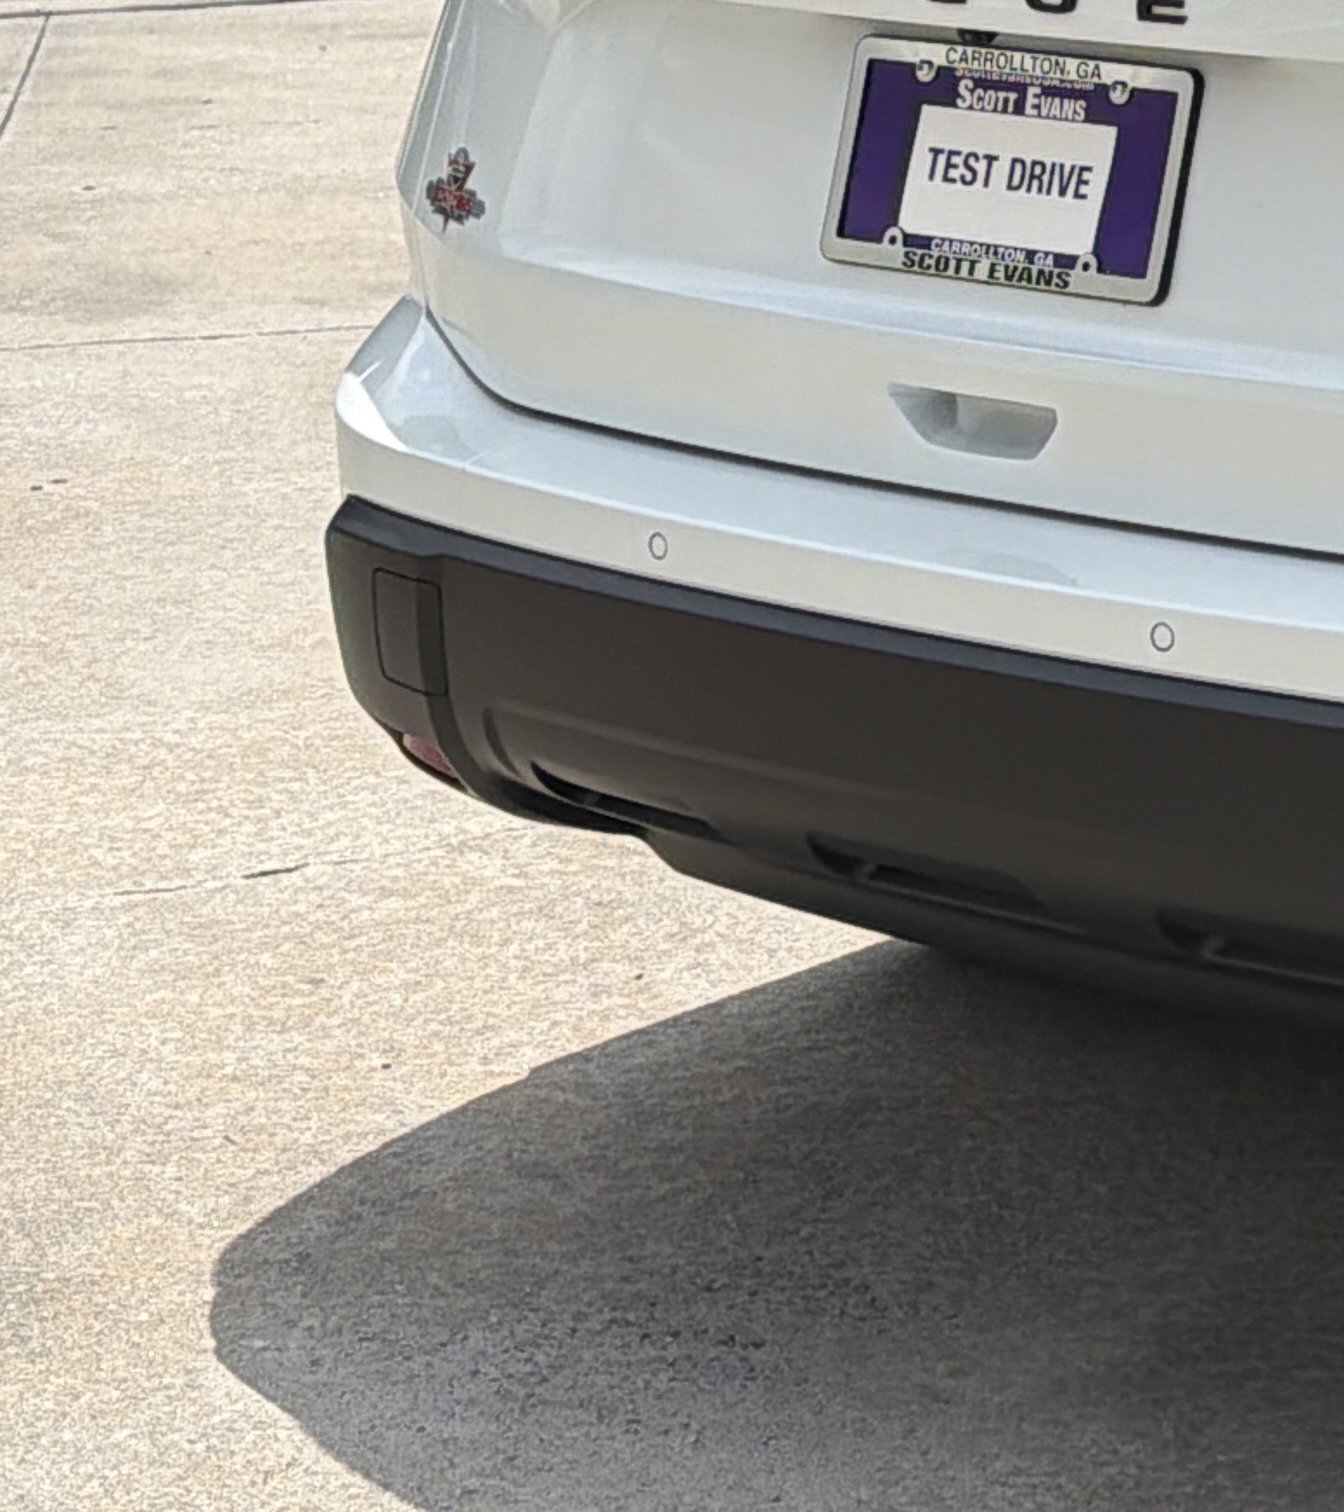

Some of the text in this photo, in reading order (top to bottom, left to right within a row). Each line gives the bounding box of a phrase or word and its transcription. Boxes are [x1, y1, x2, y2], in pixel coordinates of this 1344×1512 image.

[1076, 61, 1103, 80] GA
[928, 146, 1094, 200] TEST DRIVE
[902, 250, 1072, 289] SCOTT EVANS
[1033, 252, 1054, 267] GA
